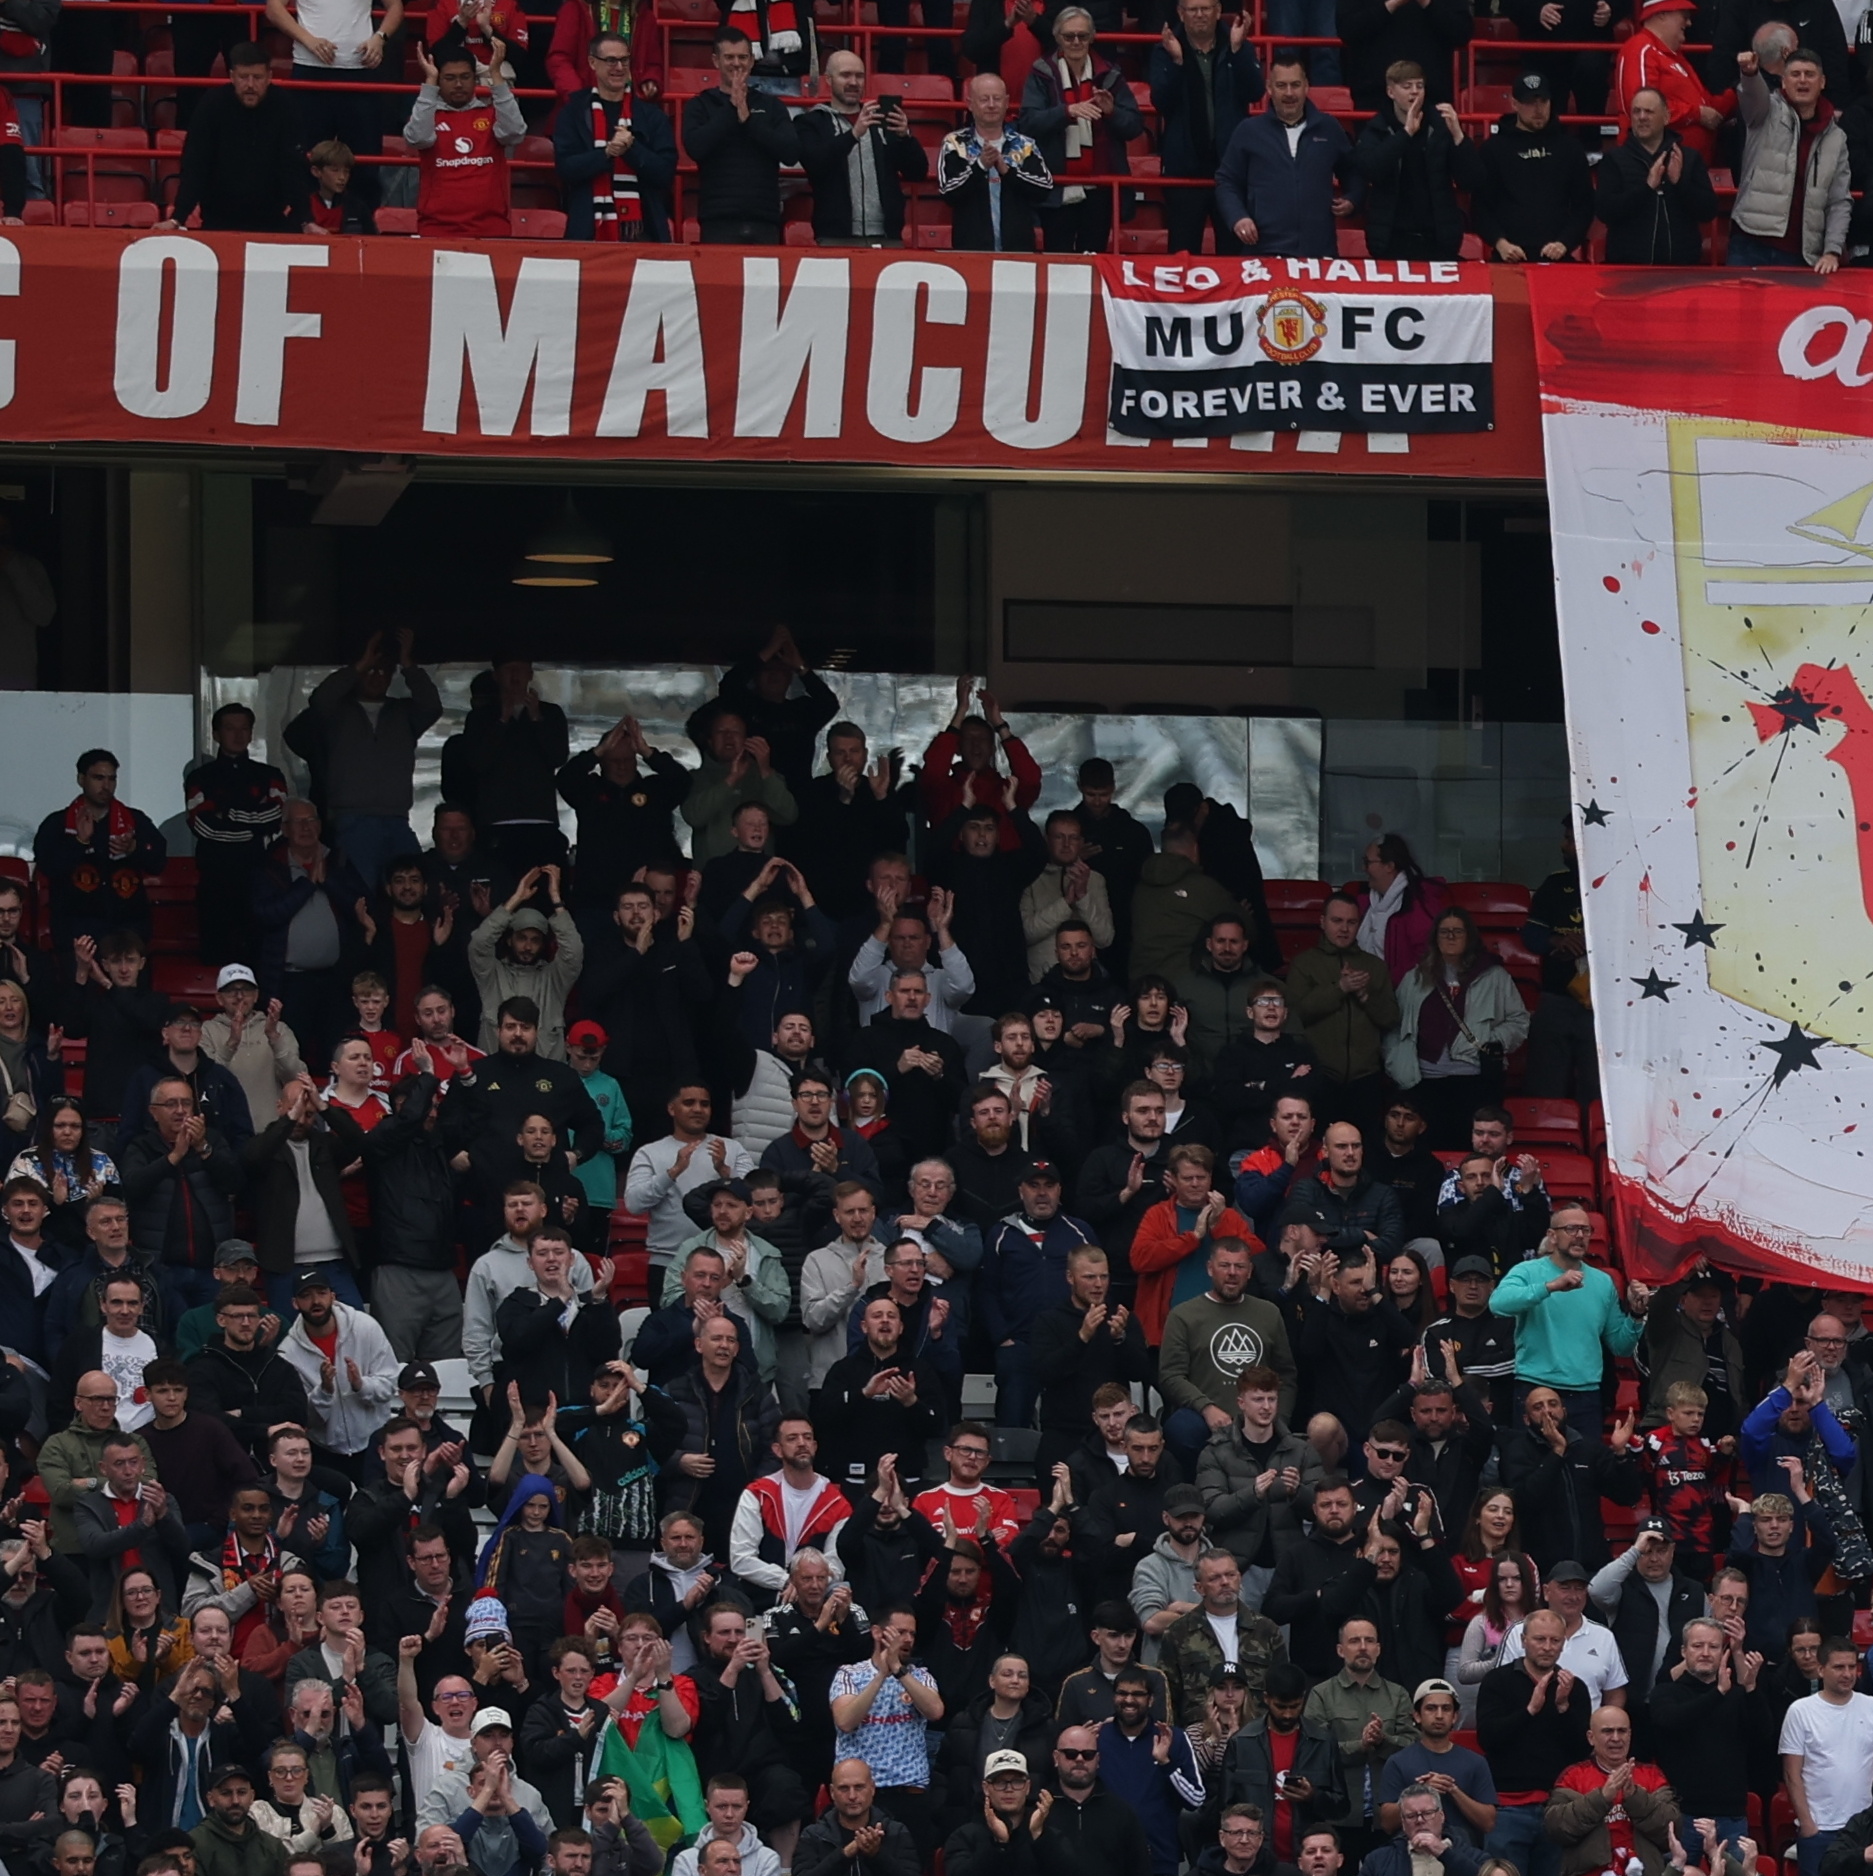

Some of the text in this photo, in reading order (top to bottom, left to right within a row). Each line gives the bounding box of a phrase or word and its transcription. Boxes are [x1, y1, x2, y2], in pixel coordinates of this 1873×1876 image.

[435, 154, 494, 168] Snapdragon
[1122, 257, 1460, 293] LEO & HALLE
[114, 235, 331, 428] OF
[1145, 307, 1426, 358] MU FC
[1121, 380, 1477, 419] FOREVER & EVER
[616, 1464, 650, 1487] adidas
[1680, 1470, 1706, 1482] Tezo
[863, 1712, 915, 1725] SHARP
